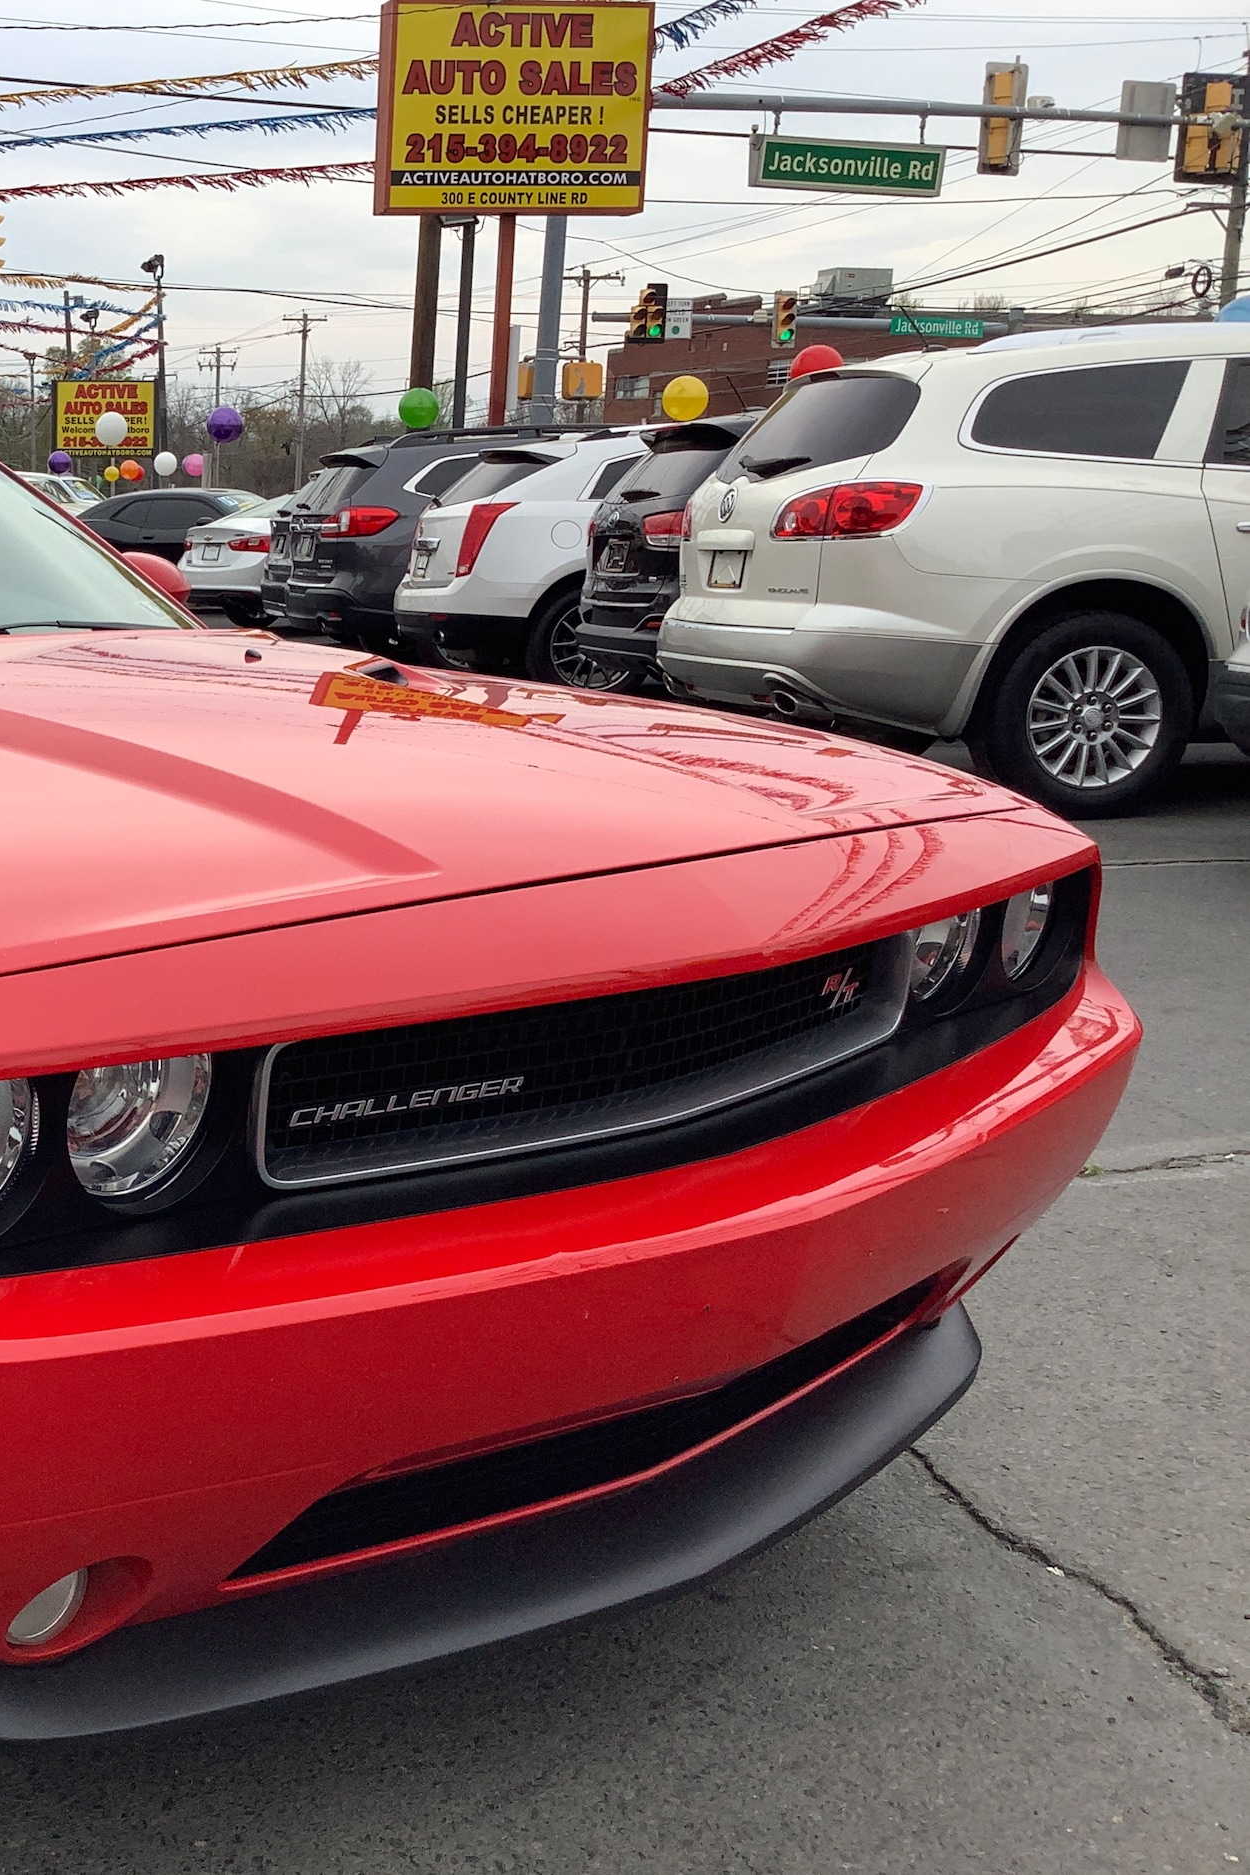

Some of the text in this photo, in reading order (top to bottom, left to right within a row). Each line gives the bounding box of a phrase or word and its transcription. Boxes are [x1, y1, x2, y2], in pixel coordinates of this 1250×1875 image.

[451, 12, 594, 48] ACTIVE
[402, 60, 638, 97] AUTO SALES
[435, 105, 494, 125] SELLS
[502, 105, 592, 125] CHEAPER
[404, 133, 628, 164] 215-394-8922
[768, 151, 935, 181] Jacksonville Rd
[401, 172, 628, 185] ACTIVEAUTOHATBORO.COM
[441, 192, 588, 205] 300 E COUNTY LINE RD
[964, 321, 979, 335] Rd
[75, 384, 138, 399] ACTIVE
[64, 402, 148, 415] AUTO SALES
[64, 417, 95, 425] SELLS
[821, 967, 860, 1009] R/T
[289, 1076, 525, 1127] CHALLENGER
